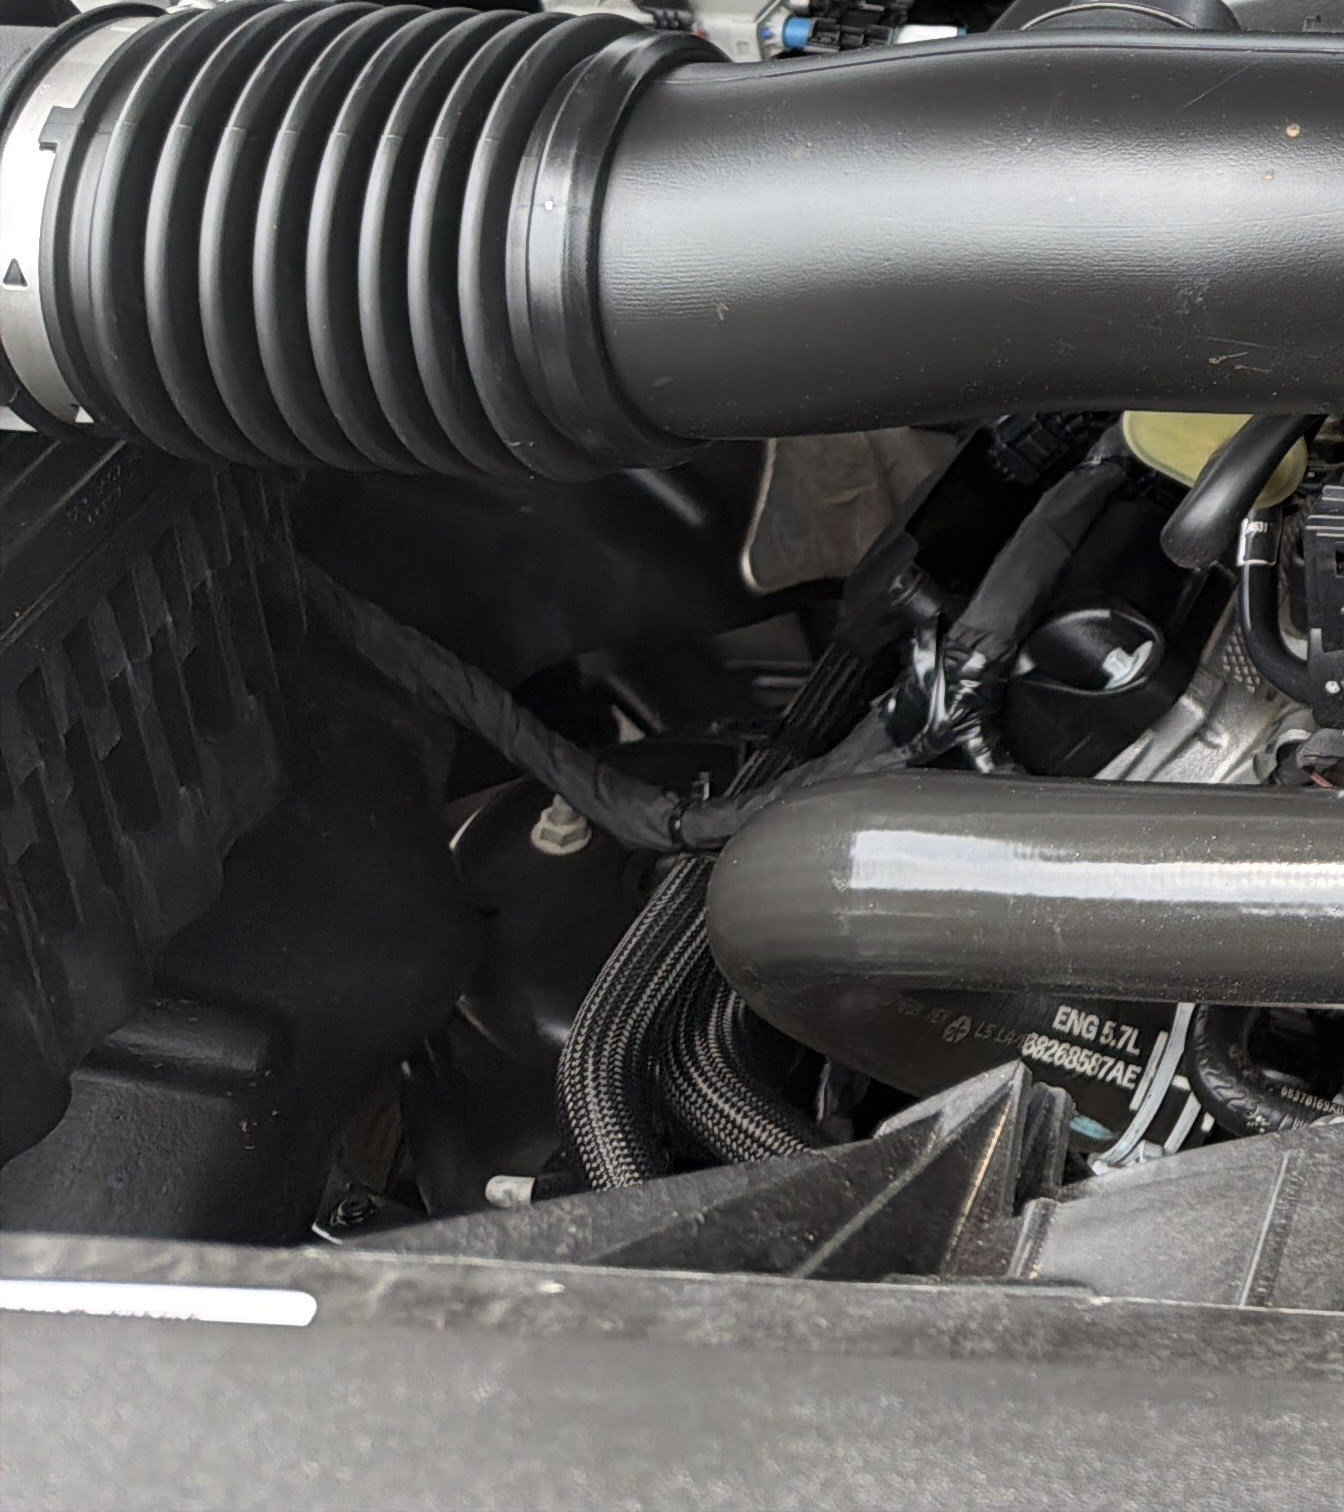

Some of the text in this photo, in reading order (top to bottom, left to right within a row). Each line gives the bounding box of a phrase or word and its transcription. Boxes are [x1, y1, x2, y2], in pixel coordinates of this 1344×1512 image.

[1051, 1004, 1099, 1040] ENG
[1098, 1019, 1142, 1056] 5.7L
[1020, 1031, 1144, 1090] 68268587AE
